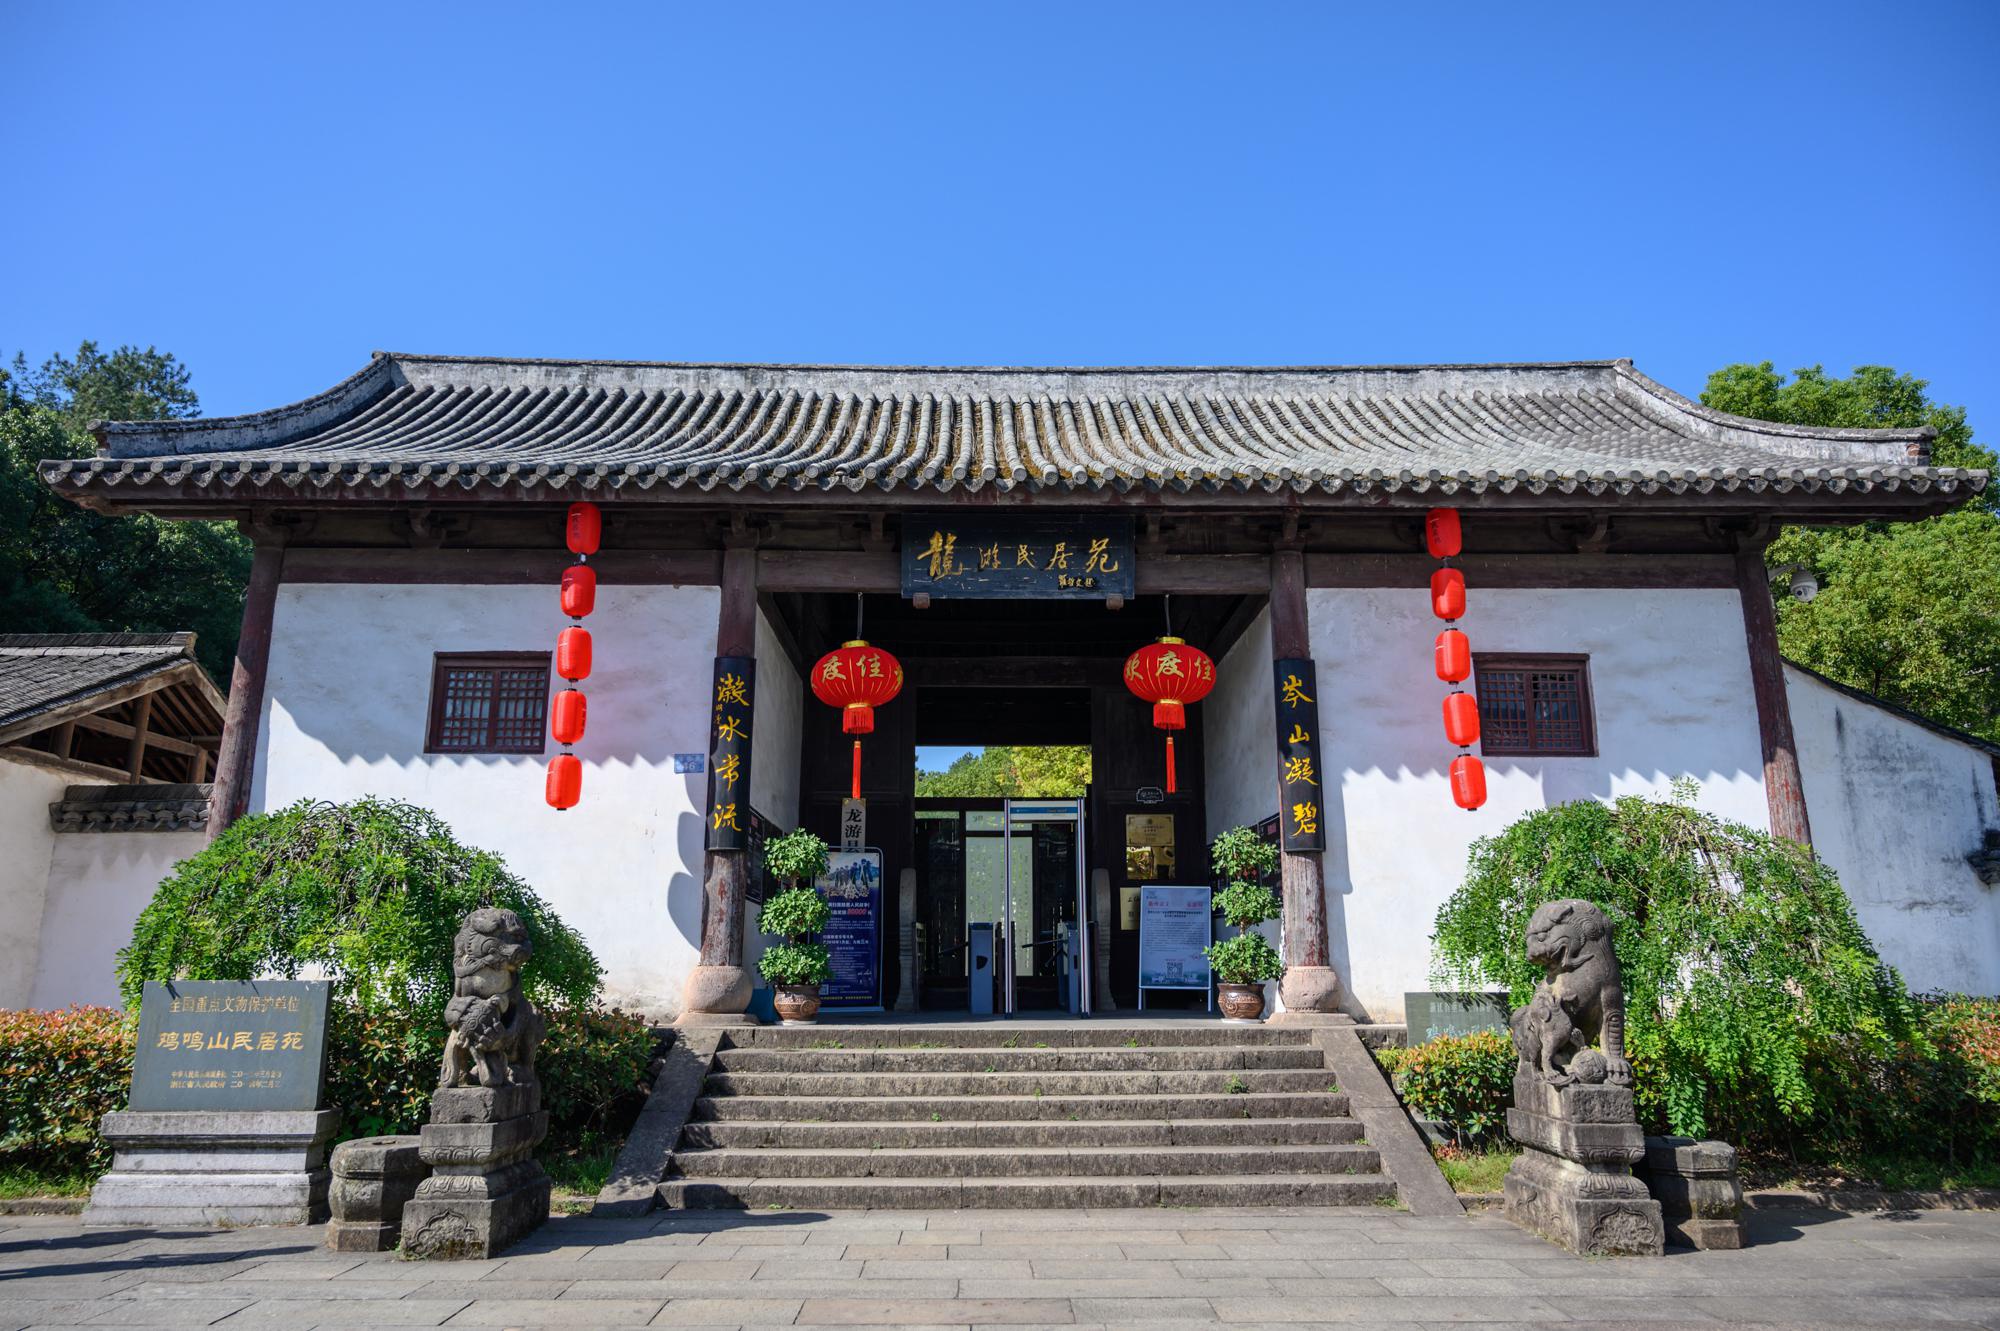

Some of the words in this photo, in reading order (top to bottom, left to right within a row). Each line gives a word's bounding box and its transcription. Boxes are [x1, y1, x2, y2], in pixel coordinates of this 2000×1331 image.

[169, 996, 299, 1013] 全国重点文物保护单位
[157, 1031, 305, 1051] 鸡鸣山民居苑
